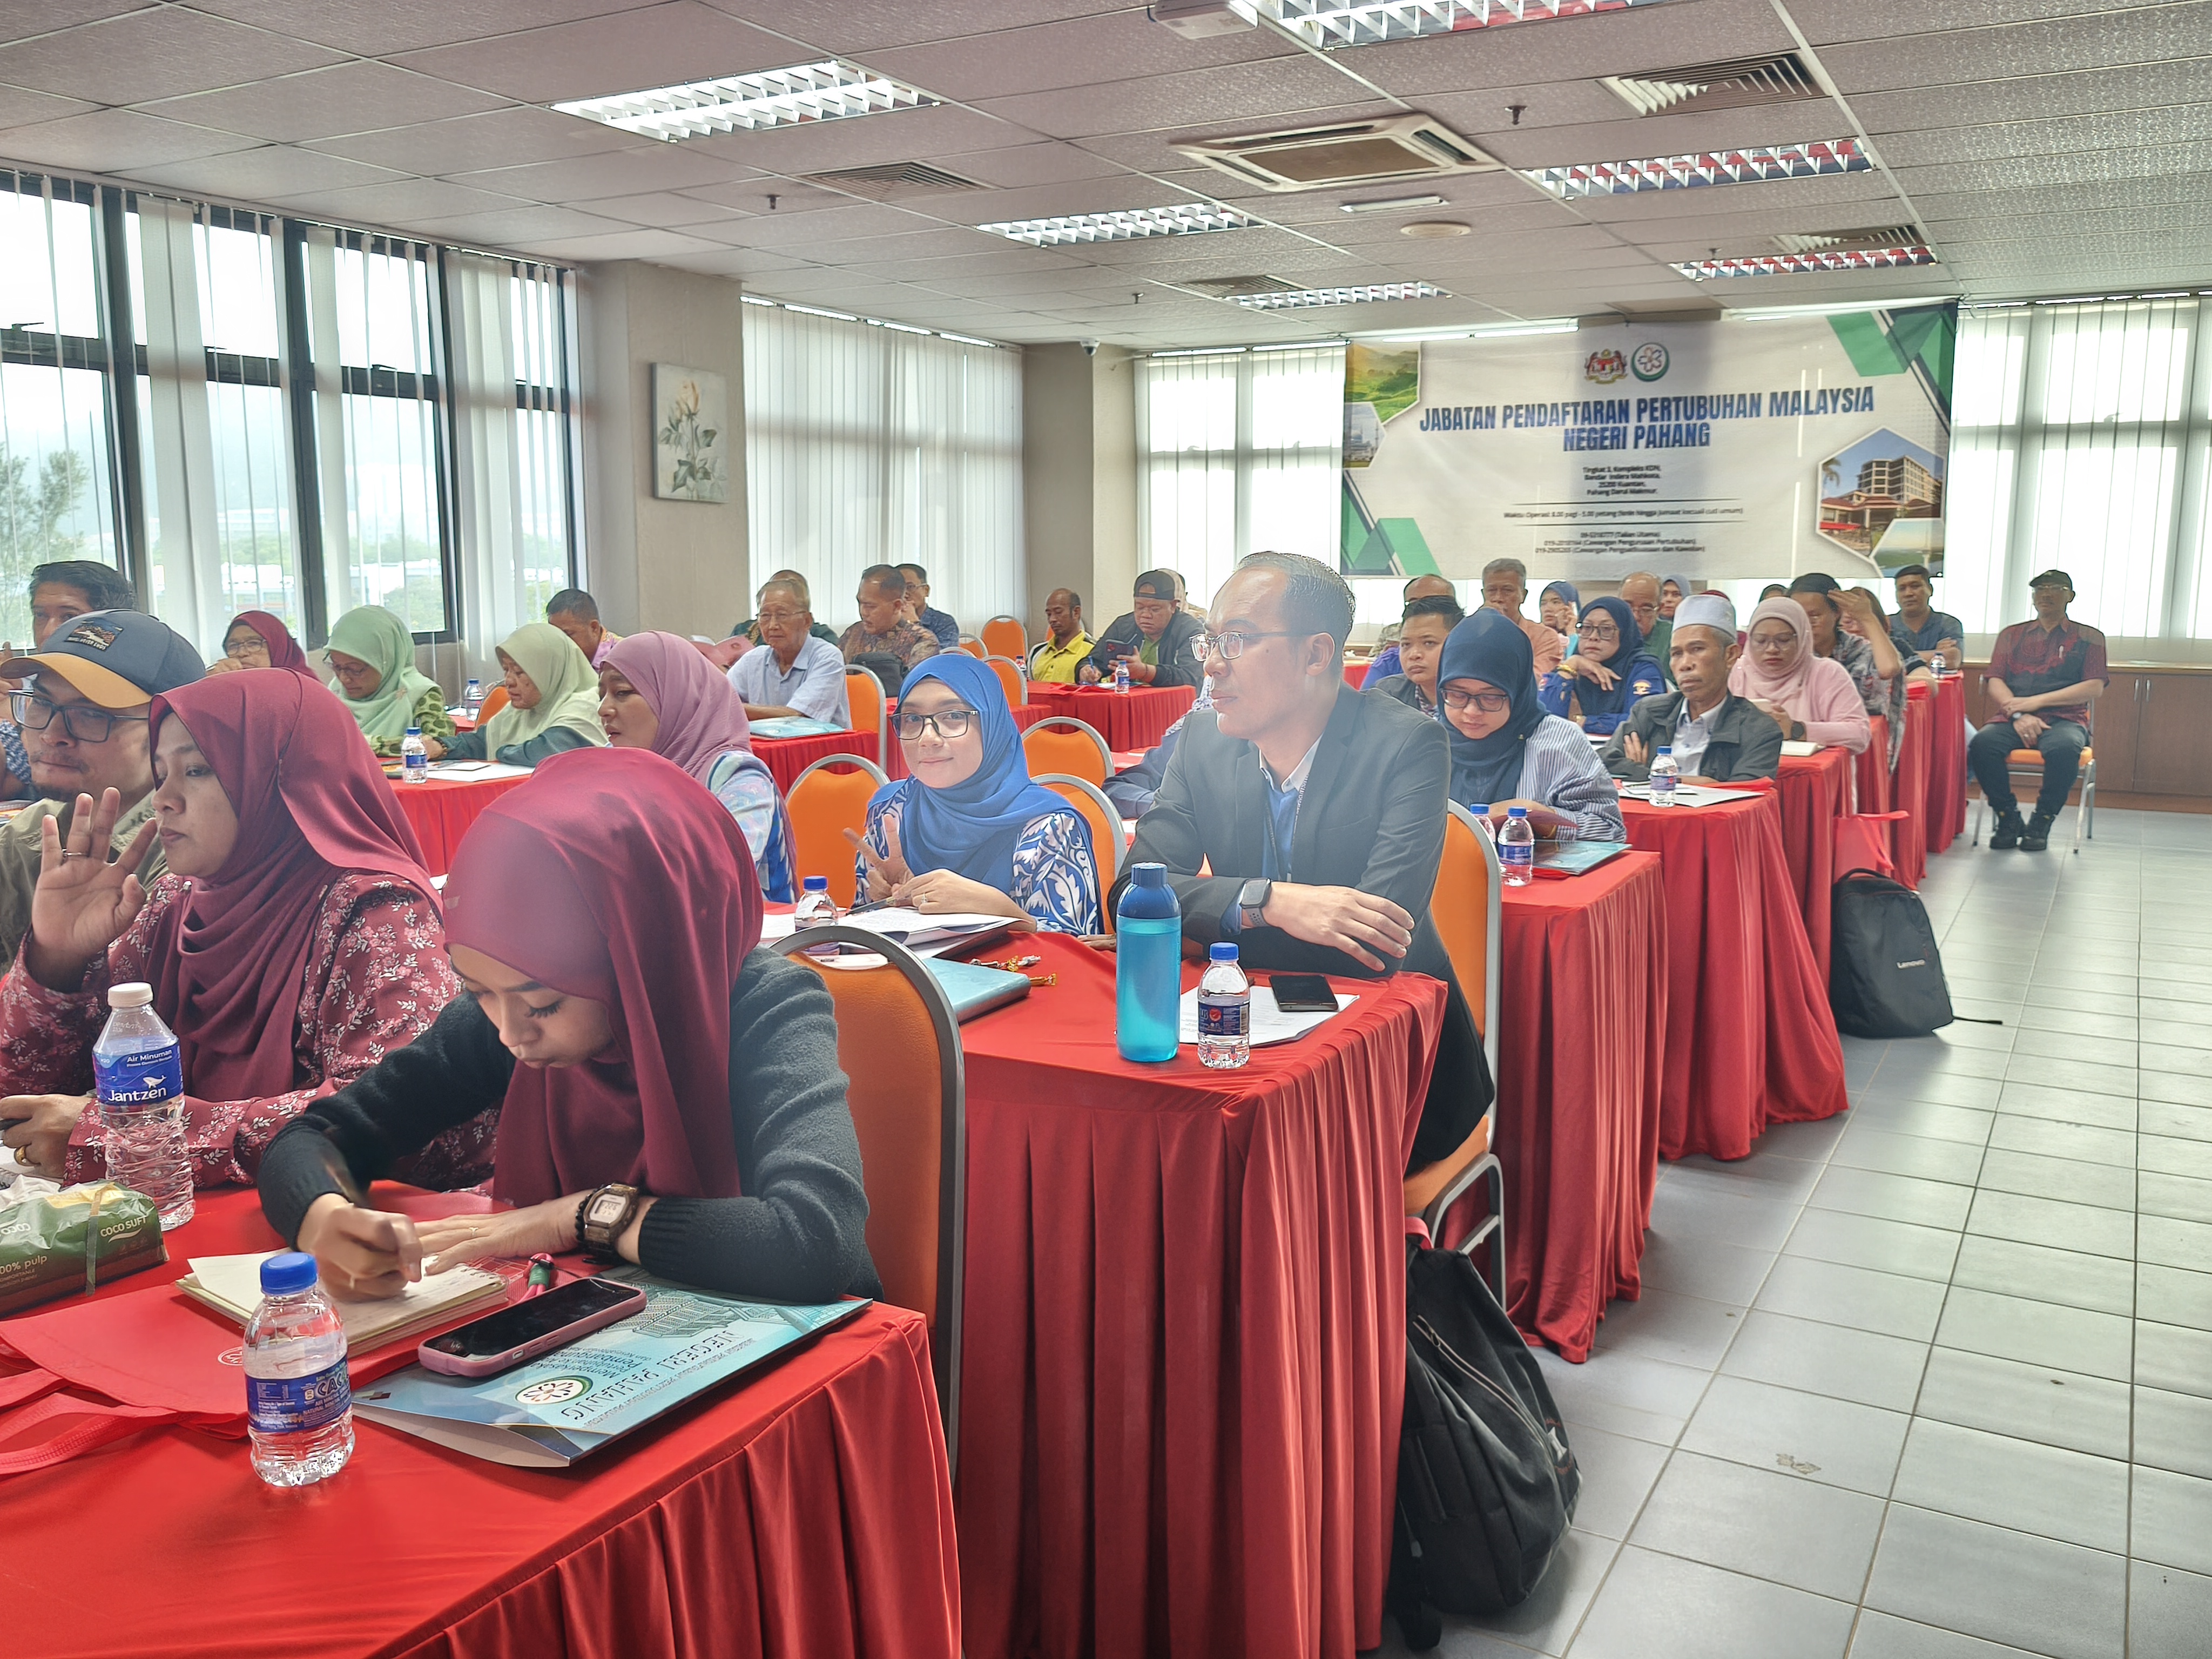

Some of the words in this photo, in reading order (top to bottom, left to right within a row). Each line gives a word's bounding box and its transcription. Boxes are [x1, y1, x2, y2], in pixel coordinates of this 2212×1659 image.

[1420, 406, 1496, 431] JABATAN
[1502, 399, 1630, 428] PENDAFTARAN
[1636, 393, 1762, 423] PERTUBUHAN
[1769, 386, 1874, 417] MALAYSIA
[1563, 426, 1628, 451] NEGERI
[1633, 422, 1710, 449] PAHANG
[140, 1049, 172, 1061] Minuman
[108, 1087, 166, 1102] Jantzen
[100, 1223, 125, 1237] COCO
[0, 1261, 21, 1274] 00%
[24, 1255, 48, 1269] pulp
[656, 1330, 744, 1370] NEGERI
[561, 1367, 659, 1420] PAHANG
[303, 1406, 323, 1415] NATURAL
